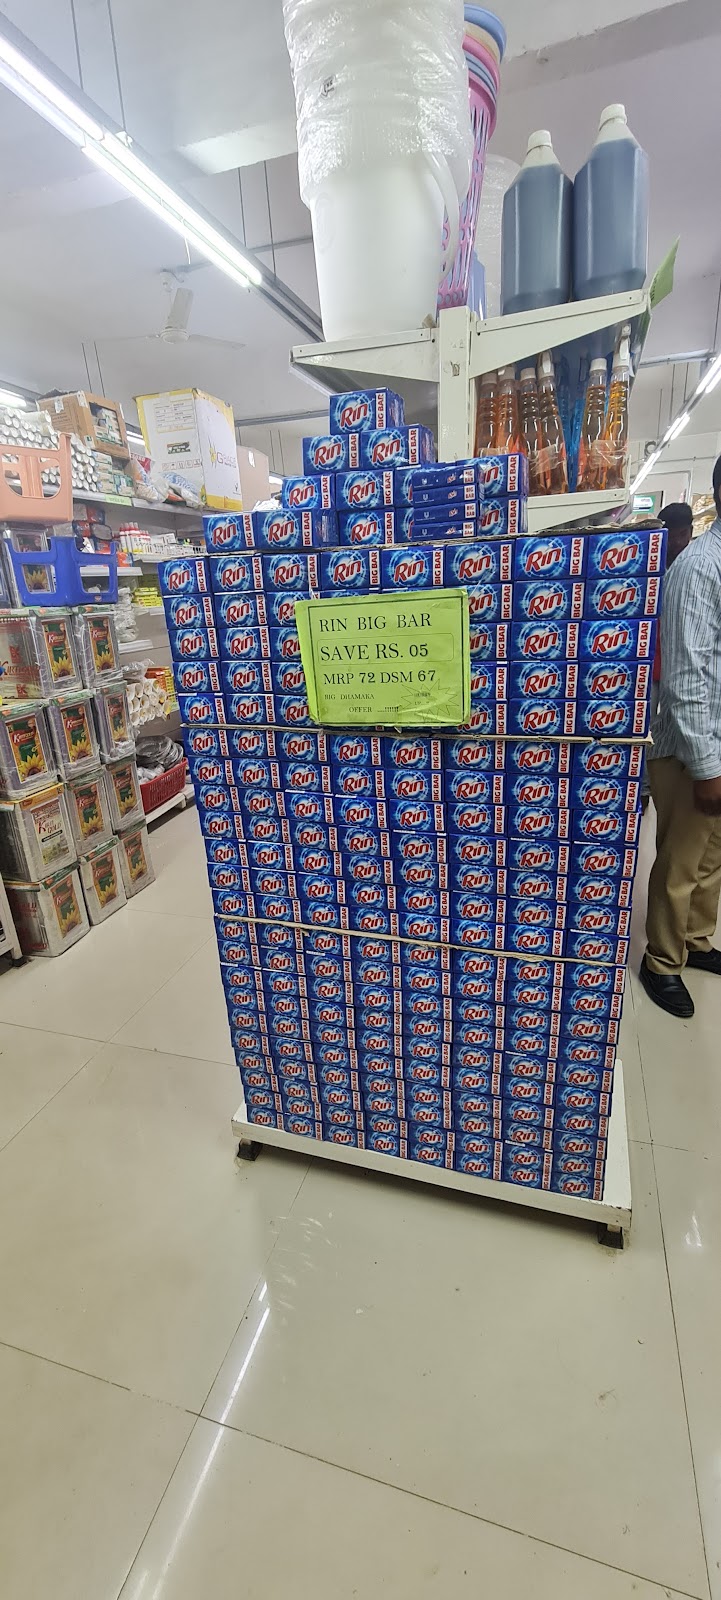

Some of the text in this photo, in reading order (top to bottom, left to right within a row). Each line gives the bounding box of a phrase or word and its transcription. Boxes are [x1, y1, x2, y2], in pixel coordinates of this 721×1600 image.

[341, 404, 368, 427] Rin
[315, 444, 341, 464] Rin
[373, 440, 400, 462] Rin
[289, 486, 314, 505] Rin
[349, 482, 375, 503] Rin
[213, 525, 236, 544] Rin
[268, 522, 294, 541] Rin
[351, 522, 377, 541] Rin
[525, 549, 561, 571] Rin
[571, 539, 582, 575] BIG BAR
[600, 545, 638, 570] Rin
[648, 534, 659, 571] BIG BAR
[275, 564, 300, 583] Rin
[334, 561, 361, 581] Rin
[394, 561, 424, 581] Rin
[459, 556, 491, 578] Rin
[169, 571, 189, 589] Rin
[222, 567, 245, 585] Rin
[598, 588, 635, 611] Rin
[646, 578, 657, 614] BIG BAR
[528, 594, 562, 615] Rin
[572, 604, 581, 618] BIG
[176, 606, 196, 624] Rin
[227, 604, 249, 622] Rin
[320, 613, 432, 632] RIN BIG BAR
[181, 636, 202, 654] Rin
[231, 636, 253, 654] Rin
[524, 632, 557, 653] Rin
[592, 631, 628, 653] Rin
[638, 622, 648, 657] BIG BAR
[282, 640, 299, 656] Ri
[320, 643, 428, 661] SAVE RS. 05
[567, 644, 576, 658] BIG
[183, 672, 203, 686] Rin
[233, 672, 255, 688] Rin
[324, 670, 436, 685] MRP 72 DSM 67
[524, 674, 557, 693] Rin
[591, 674, 626, 693] Rin
[636, 666, 647, 698] BIG BAR
[567, 683, 575, 697] BIG
[189, 706, 210, 720] Rin
[237, 702, 259, 718] Rin
[566, 703, 574, 720] BAR
[634, 701, 645, 733] BIG BAR
[523, 710, 555, 729] Rin
[590, 709, 624, 728] Rin
[193, 736, 213, 750] Rin
[287, 740, 310, 755] Rin
[396, 747, 423, 764] Rin
[458, 746, 487, 763] Rin
[518, 750, 550, 767] Rin
[586, 754, 620, 770] Rin
[629, 746, 640, 776] BIG BAR
[243, 769, 264, 783] Rin
[343, 777, 368, 791] Rin
[518, 786, 549, 801] Rin
[584, 788, 617, 804] Rin
[295, 804, 318, 816] Rin
[459, 812, 486, 827] Rin
[254, 824, 275, 837] Rin
[404, 844, 429, 856] Rin
[625, 850, 634, 865] BAR
[583, 856, 615, 870] Rin
[261, 880, 281, 891] Rin
[580, 886, 610, 899] Rin
[266, 906, 286, 916] Rin
[360, 918, 382, 928] Rin
[462, 930, 487, 942] Rin
[227, 949, 246, 960] Rin
[579, 944, 608, 957] Rin
[464, 960, 490, 973] Rin
[273, 981, 293, 991] Rin
[411, 977, 435, 988] Rin
[575, 999, 602, 1010] Rin
[236, 1016, 254, 1026] Rin
[366, 1016, 387, 1025] Rin
[516, 1039, 542, 1050] Rin
[324, 1052, 344, 1062] Rin
[413, 1068, 435, 1078] Rin
[374, 1140, 393, 1149] Rin
[418, 1150, 439, 1159] Rin
[465, 1162, 486, 1171] Rin
[512, 1171, 536, 1180] Rin
[563, 1182, 587, 1192] Rin
